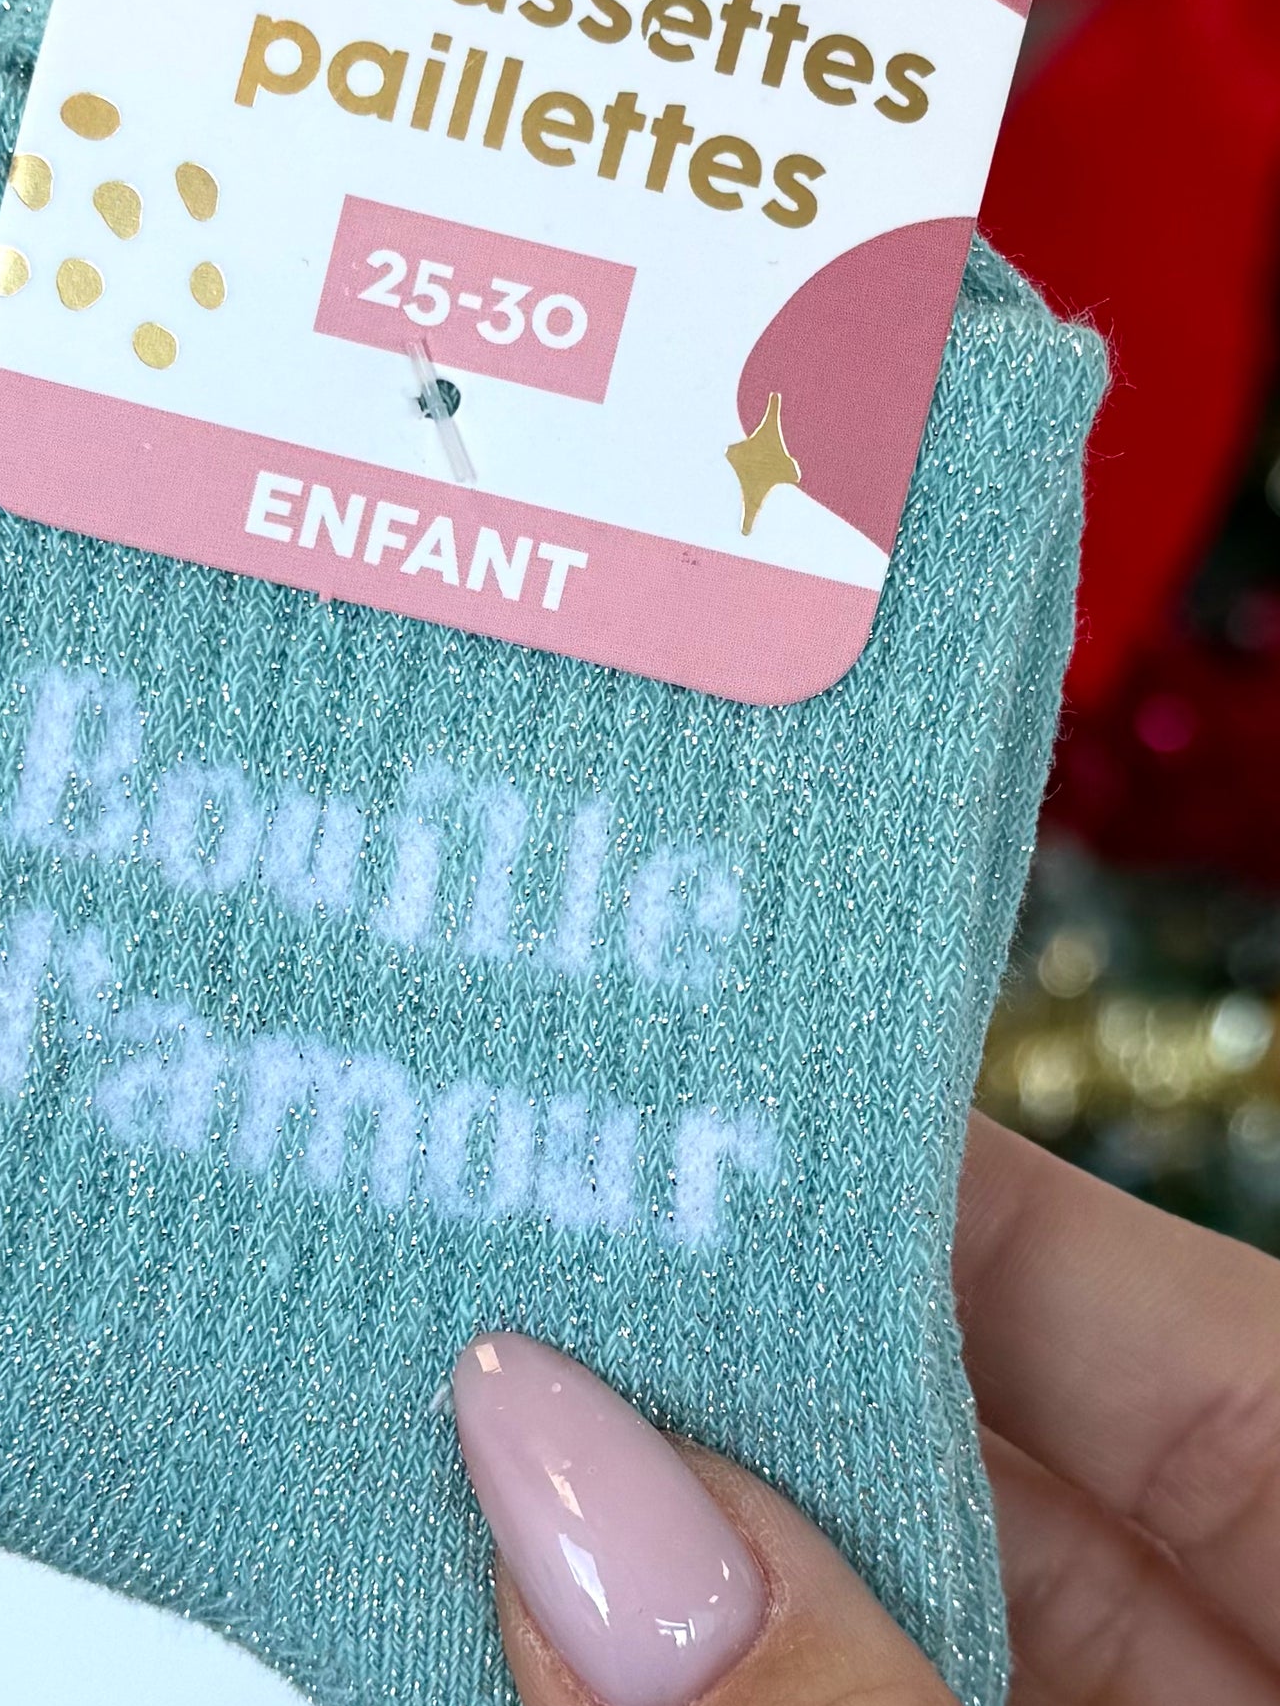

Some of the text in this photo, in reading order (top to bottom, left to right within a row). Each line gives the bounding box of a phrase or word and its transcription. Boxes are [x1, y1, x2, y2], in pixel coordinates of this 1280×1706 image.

[234, 12, 828, 230] paillettes
[357, 248, 588, 350] 25-30
[244, 471, 588, 612] ENFANT
[6, 669, 742, 989] Bouille
